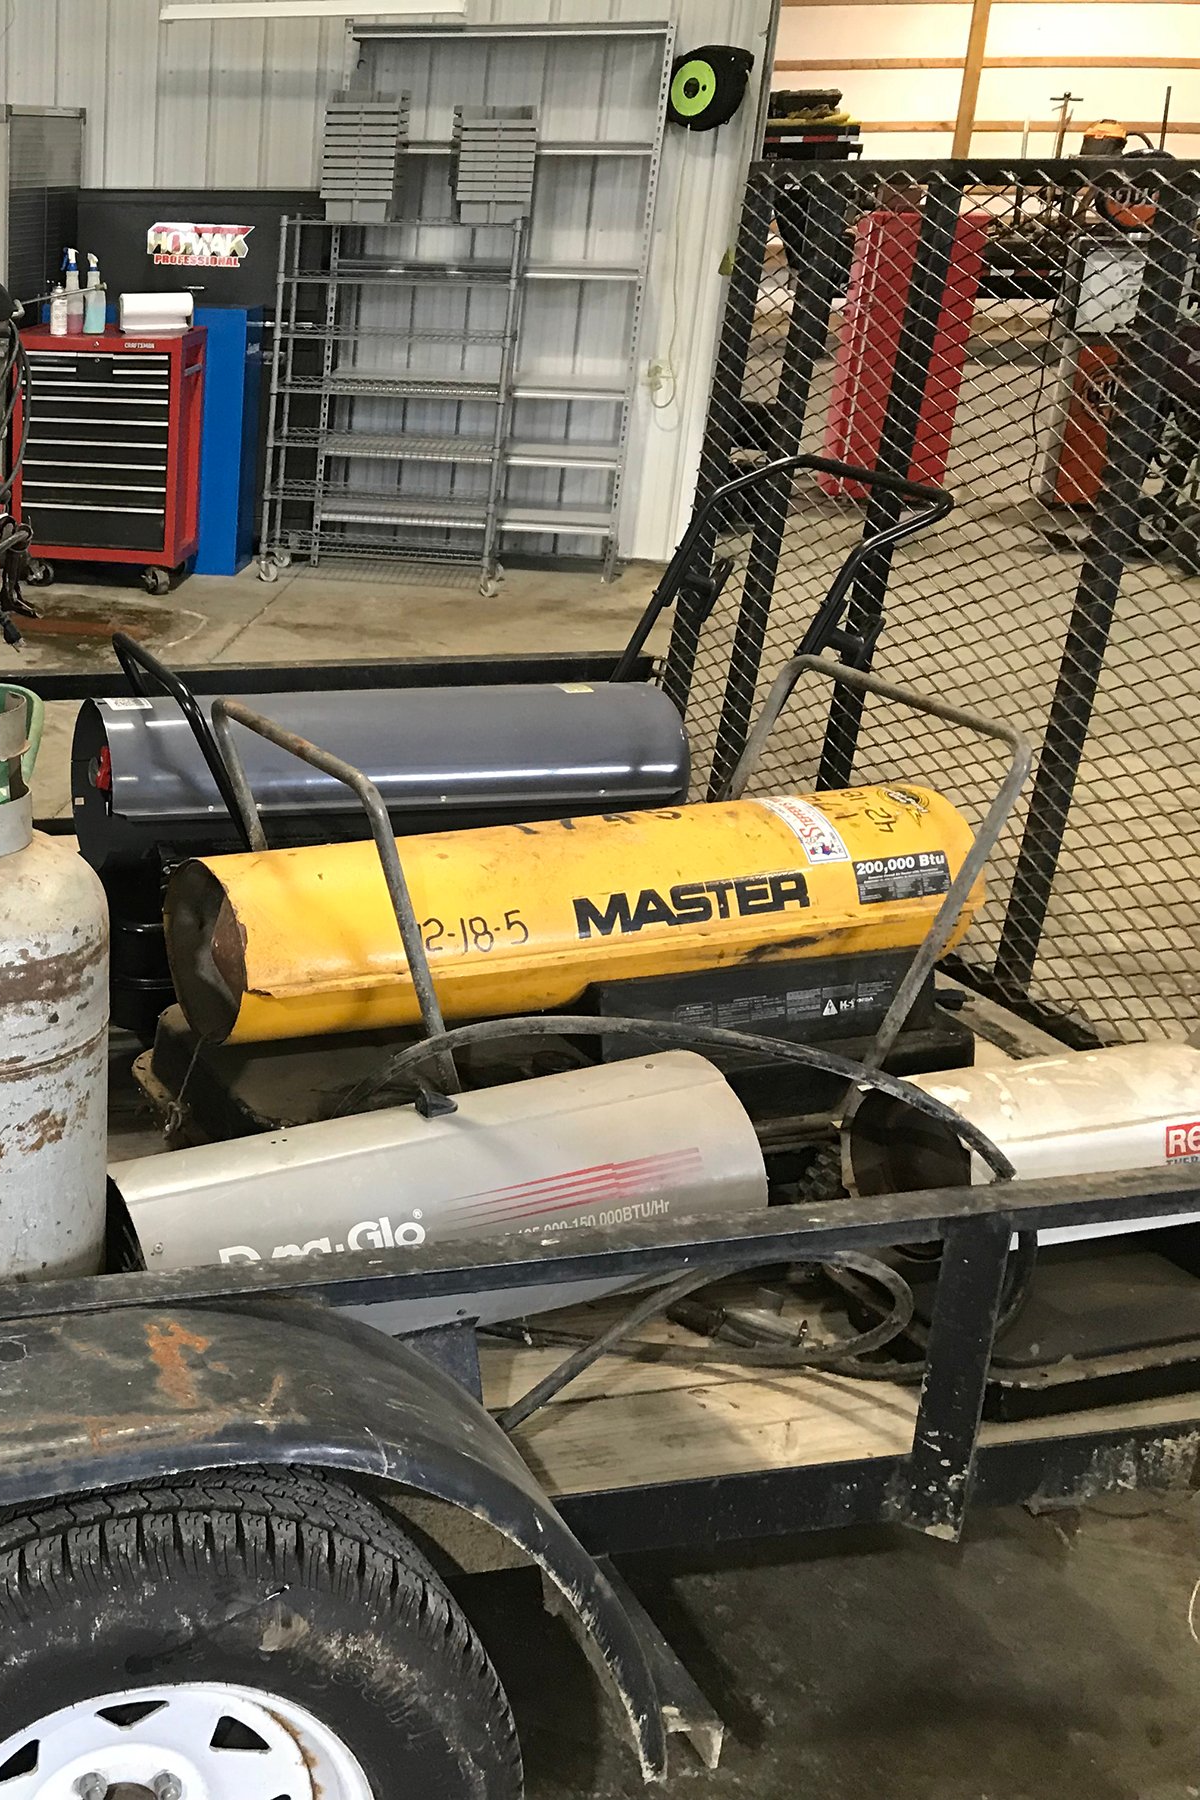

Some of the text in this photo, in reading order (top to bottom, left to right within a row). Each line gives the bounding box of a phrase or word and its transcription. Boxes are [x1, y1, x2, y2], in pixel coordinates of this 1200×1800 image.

[154, 254, 240, 267] PROFESSIONAL
[856, 857, 915, 876] 200,000
[919, 854, 945, 867] Btu
[573, 872, 810, 939] MASTER
[417, 910, 529, 953] 2-18-5
